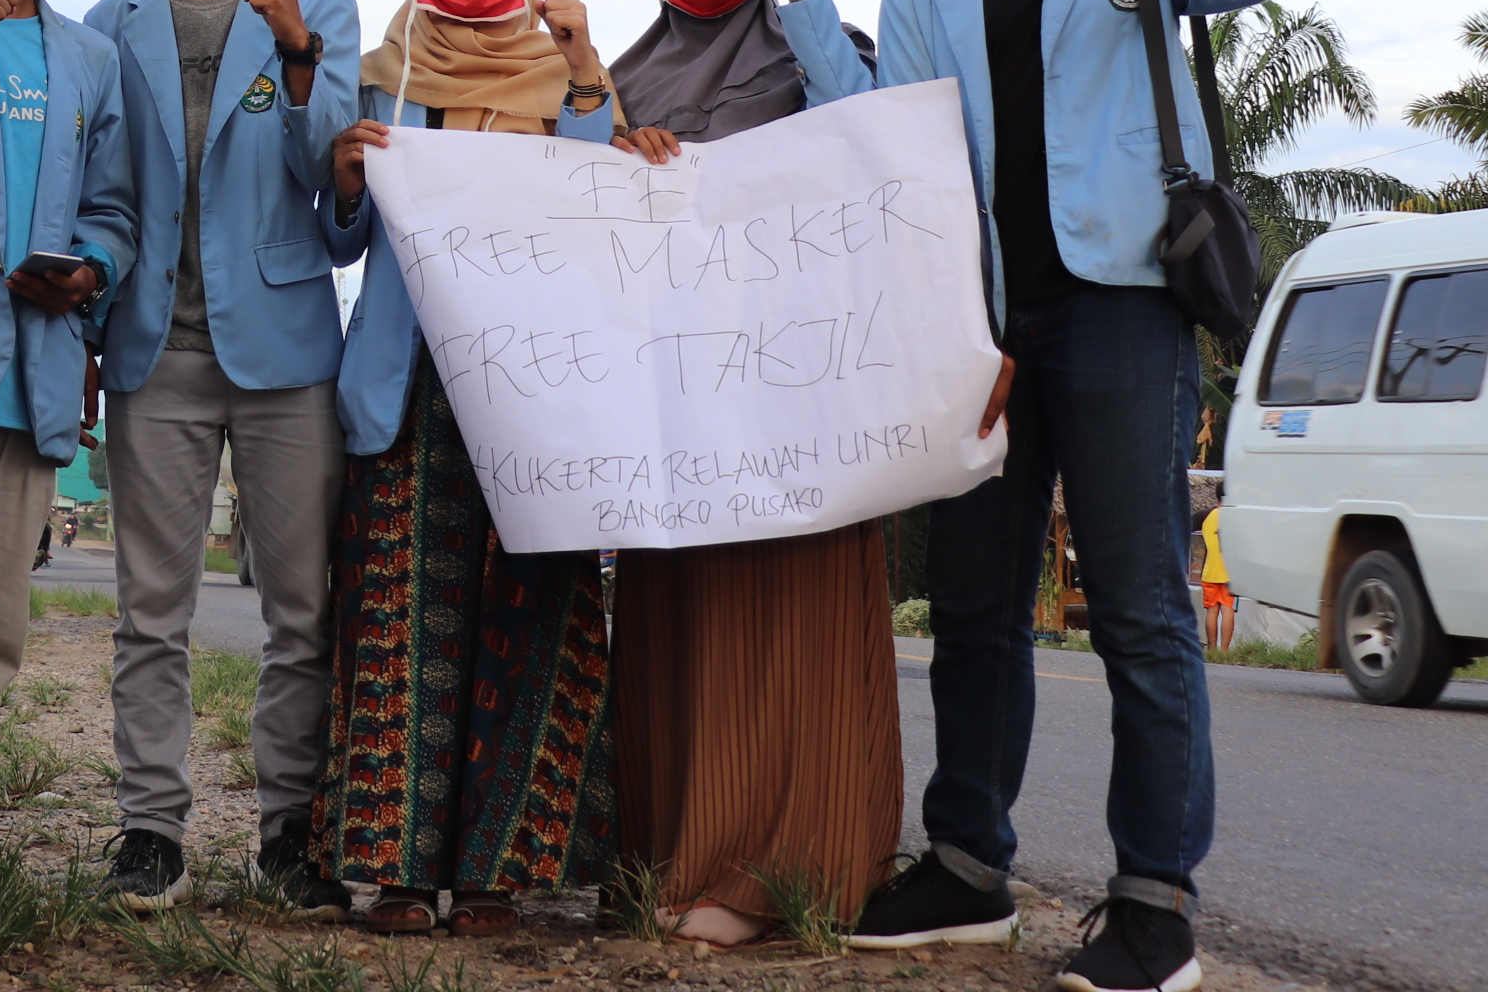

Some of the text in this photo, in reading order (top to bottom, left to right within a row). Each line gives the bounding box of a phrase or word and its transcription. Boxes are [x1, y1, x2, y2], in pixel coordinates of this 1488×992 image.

[399, 180, 944, 310] FREE MASKER
[432, 290, 895, 421] FREE TAKJIL
[591, 486, 824, 532] BANGKO PUSAKO
[662, 437, 820, 494] RELAWAN
[837, 424, 929, 466] UNRI
